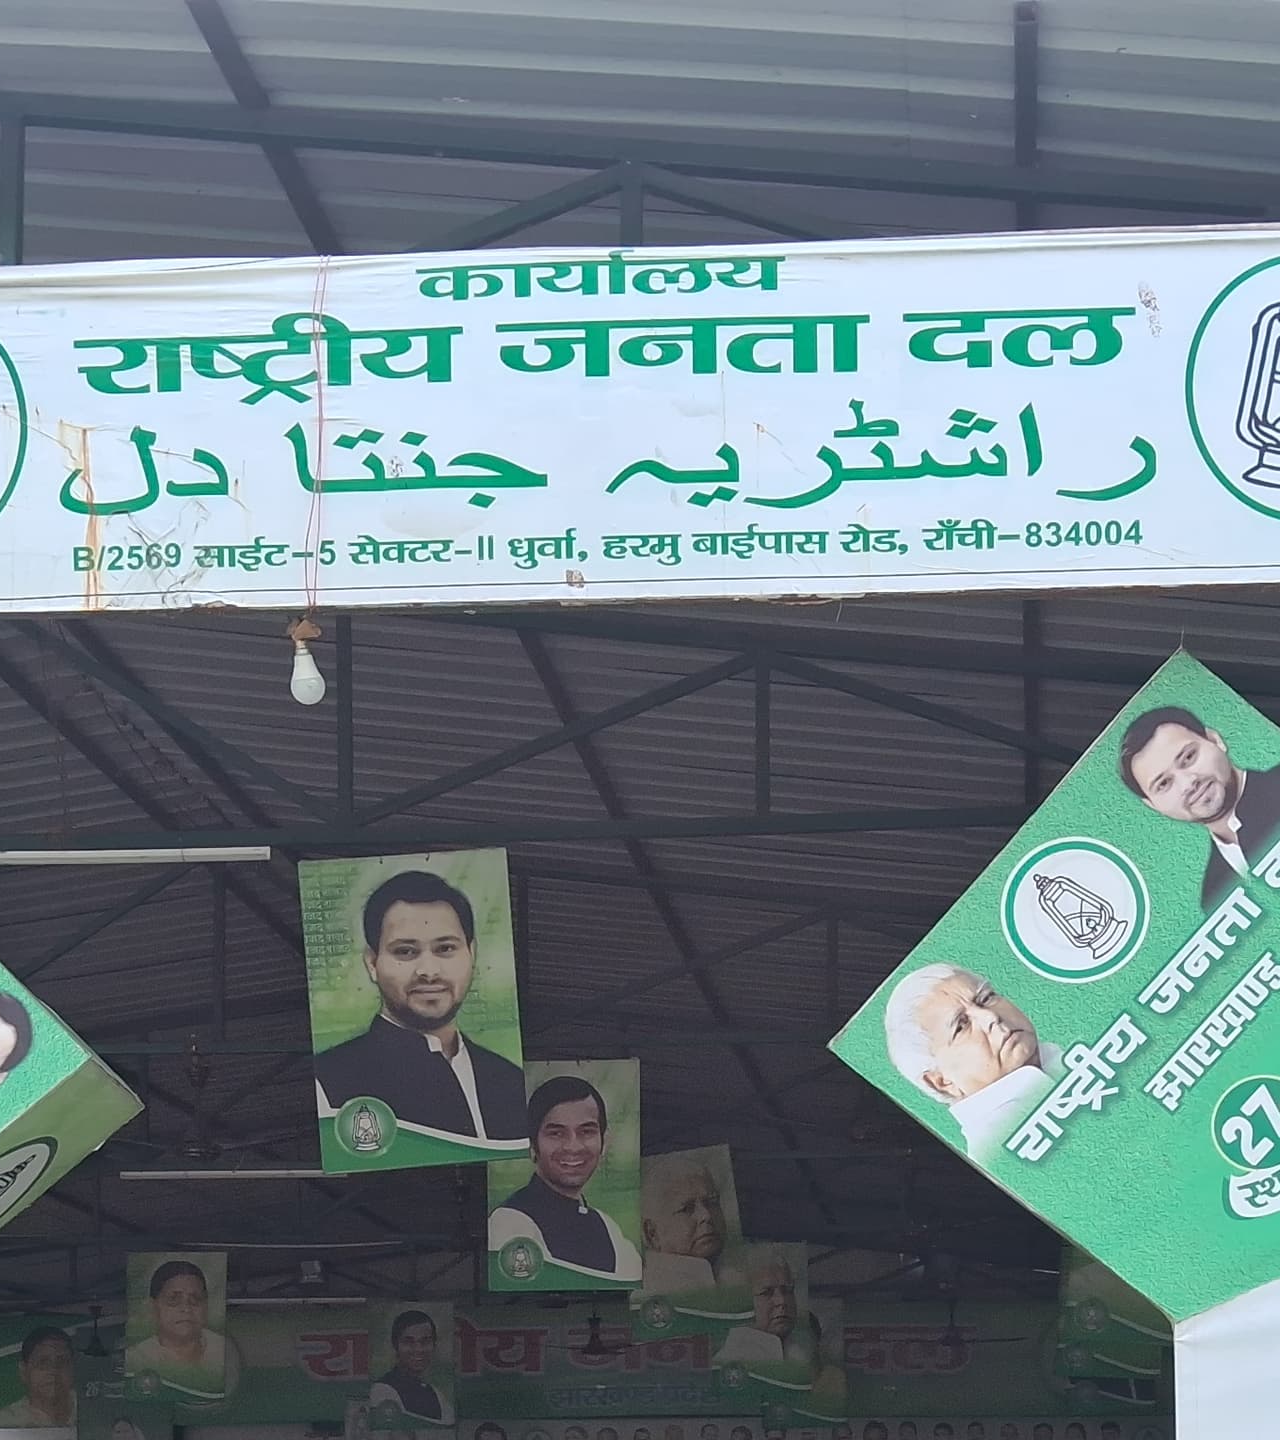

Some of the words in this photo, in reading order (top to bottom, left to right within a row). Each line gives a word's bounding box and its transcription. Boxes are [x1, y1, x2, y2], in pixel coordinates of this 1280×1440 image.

[416, 250, 785, 300] कार्यालय
[73, 312, 463, 405] राष्ट्रीय
[496, 314, 870, 378] जनता
[903, 307, 1136, 369] दल
[59, 424, 229, 516] دل
[284, 422, 548, 508] جنتا
[72, 541, 181, 573] B/2569
[507, 528, 588, 570] धुर्वा,
[602, 531, 682, 566] हरमु
[692, 524, 828, 560] बाईपास
[839, 522, 909, 557] रोड,
[1006, 1013, 1149, 1162] राष्ट्रीय
[1138, 887, 1263, 1015] जनता
